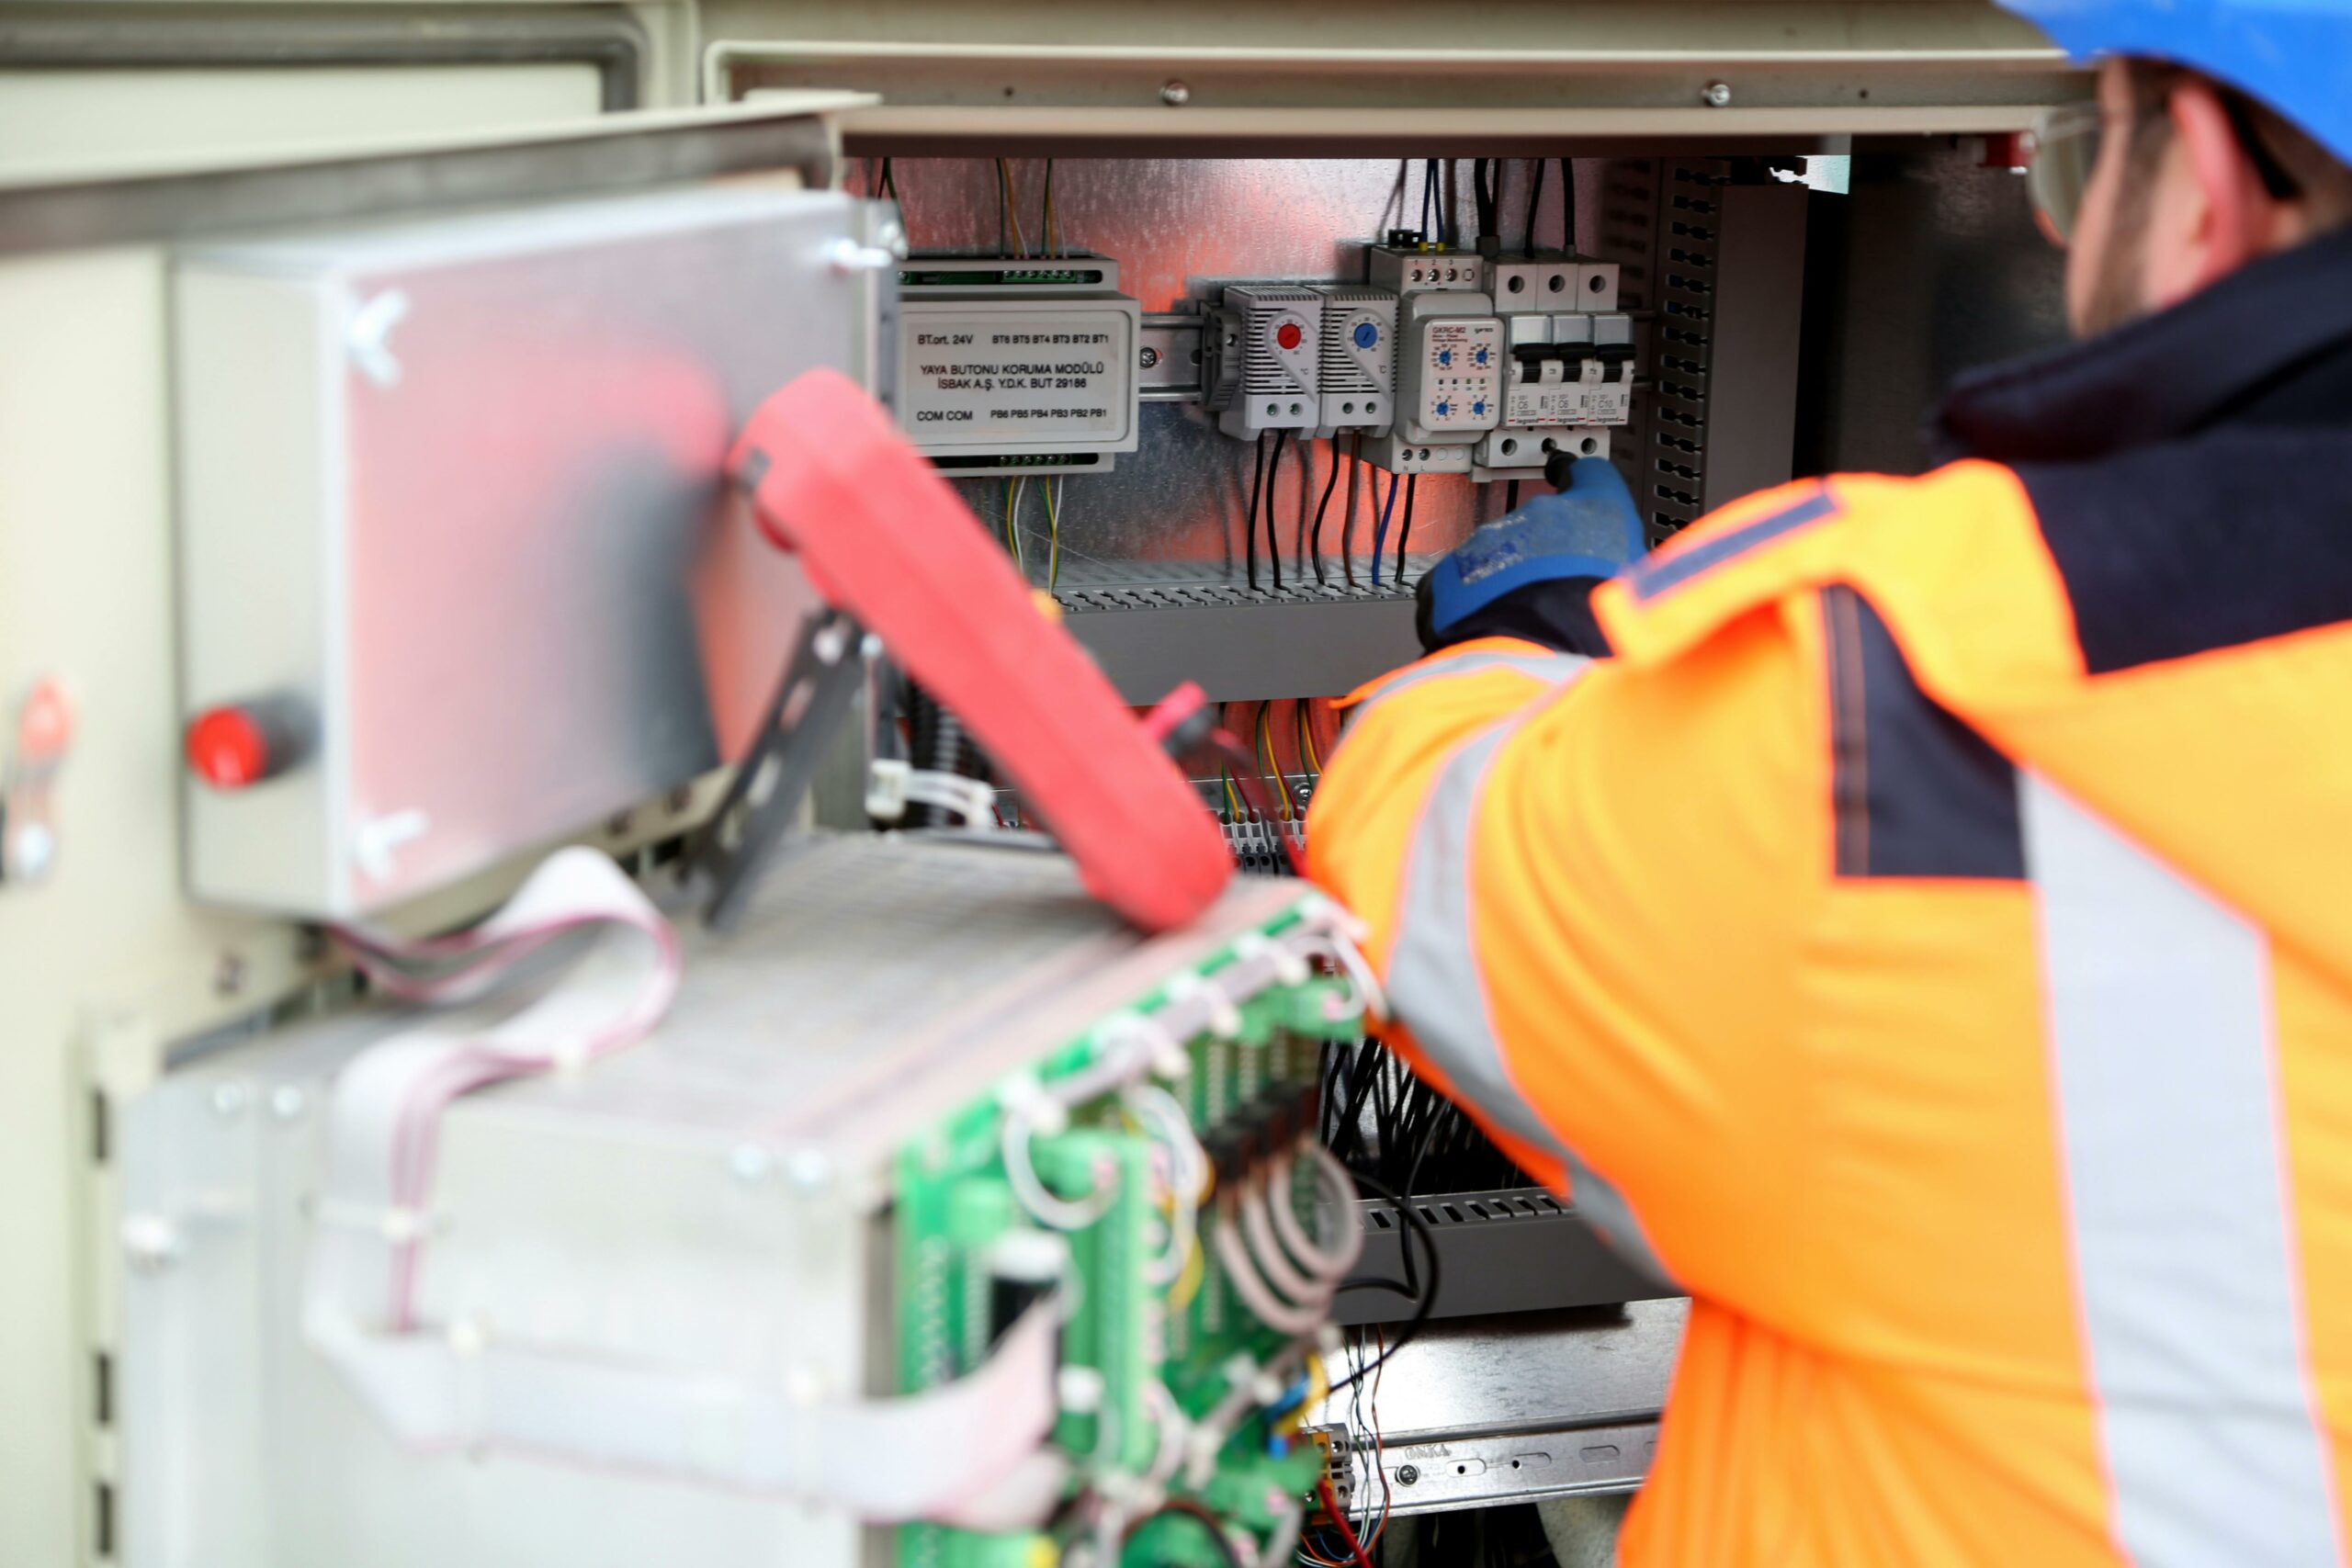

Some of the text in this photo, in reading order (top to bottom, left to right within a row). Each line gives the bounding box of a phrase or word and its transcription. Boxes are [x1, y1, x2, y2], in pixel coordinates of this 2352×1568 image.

[953, 334, 973, 344] 24V
[1012, 334, 1030, 344] BT5
[1033, 334, 1050, 344] BT4
[1053, 334, 1070, 344] BT3
[1072, 334, 1090, 344] BT2
[1092, 334, 1109, 344] BT1
[921, 361, 1103, 376] YAYA BUTONU KORUMA MODÜLÜ
[938, 377, 970, 389] İSBAK
[974, 378, 995, 391] A.Ş.
[999, 378, 1026, 389] Y.D.K.
[1031, 378, 1053, 389] BUT
[917, 412, 973, 422] COM COM
[1011, 410, 1028, 419] PB5
[1031, 410, 1048, 418] PB4
[1050, 410, 1069, 418] PB3
[1070, 409, 1088, 418] PB2
[1090, 409, 1107, 418] PB1
